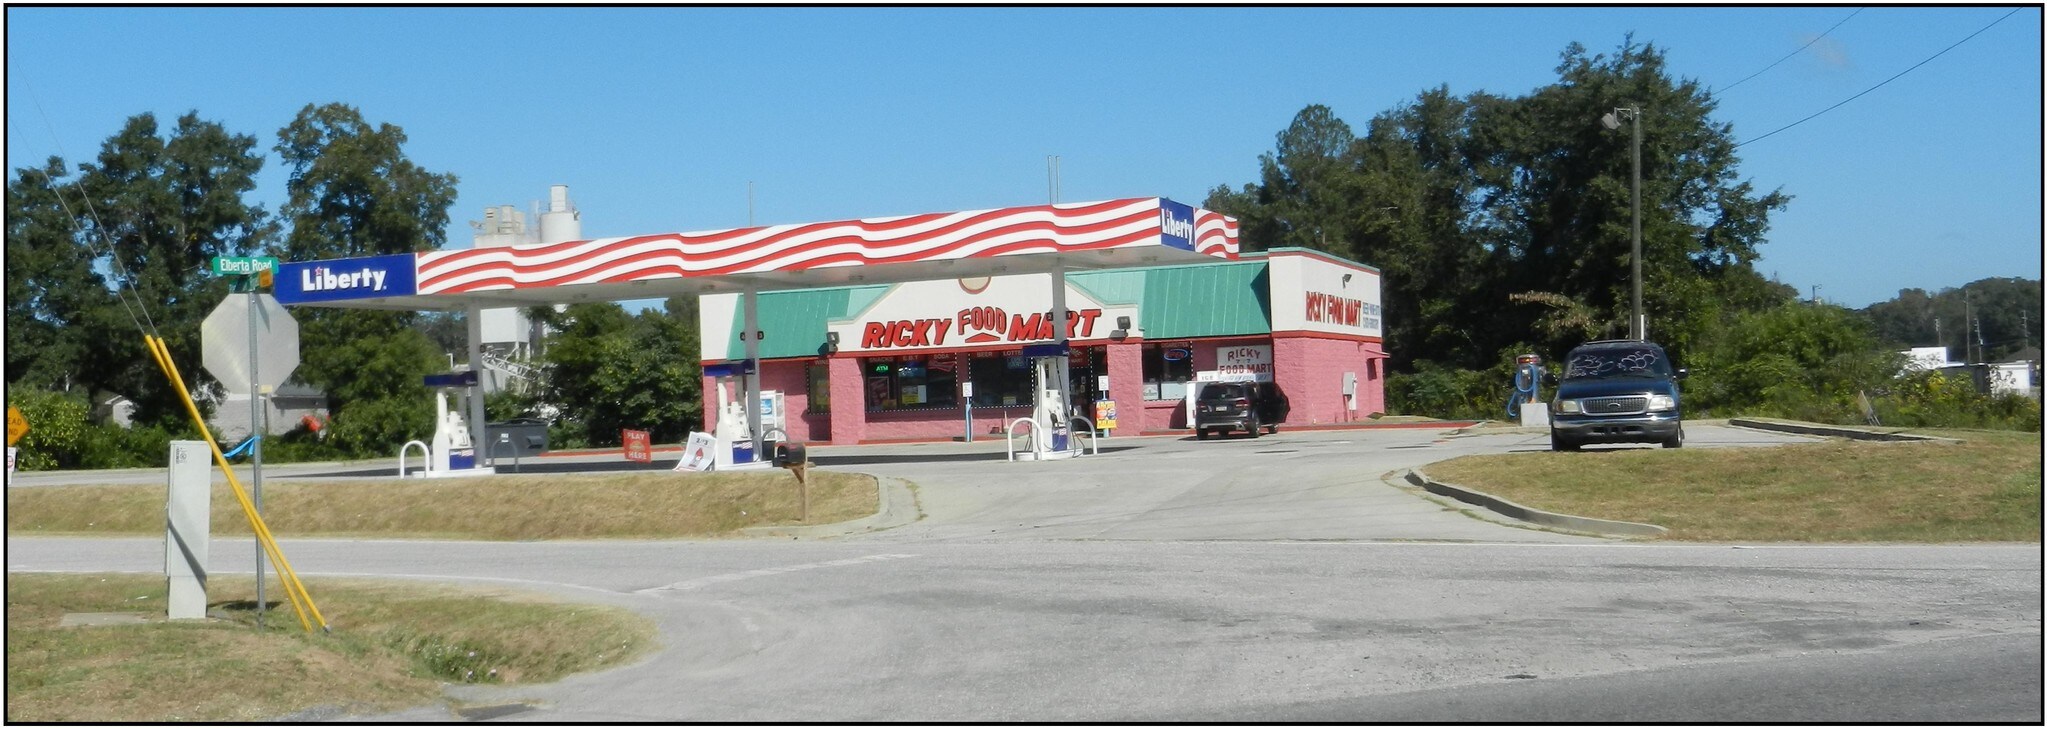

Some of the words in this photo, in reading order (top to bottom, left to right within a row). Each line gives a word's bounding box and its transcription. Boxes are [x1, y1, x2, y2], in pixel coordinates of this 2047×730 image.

[1161, 208, 1193, 246] Liberty
[220, 259, 249, 271] Elberta
[252, 259, 272, 271] Road
[303, 267, 386, 291] Liberty
[1306, 290, 1326, 323] RICKY
[1327, 295, 1343, 325] FOOD
[1345, 297, 1361, 327] MART
[861, 318, 952, 348] RICKY
[958, 306, 1007, 336] FOOD
[1007, 309, 1102, 341] MART
[1227, 348, 1260, 361] RICKY
[1219, 364, 1245, 374] FOOD
[1246, 363, 1272, 374] MART
[627, 432, 645, 440] PLAY
[629, 451, 647, 460] HERE
